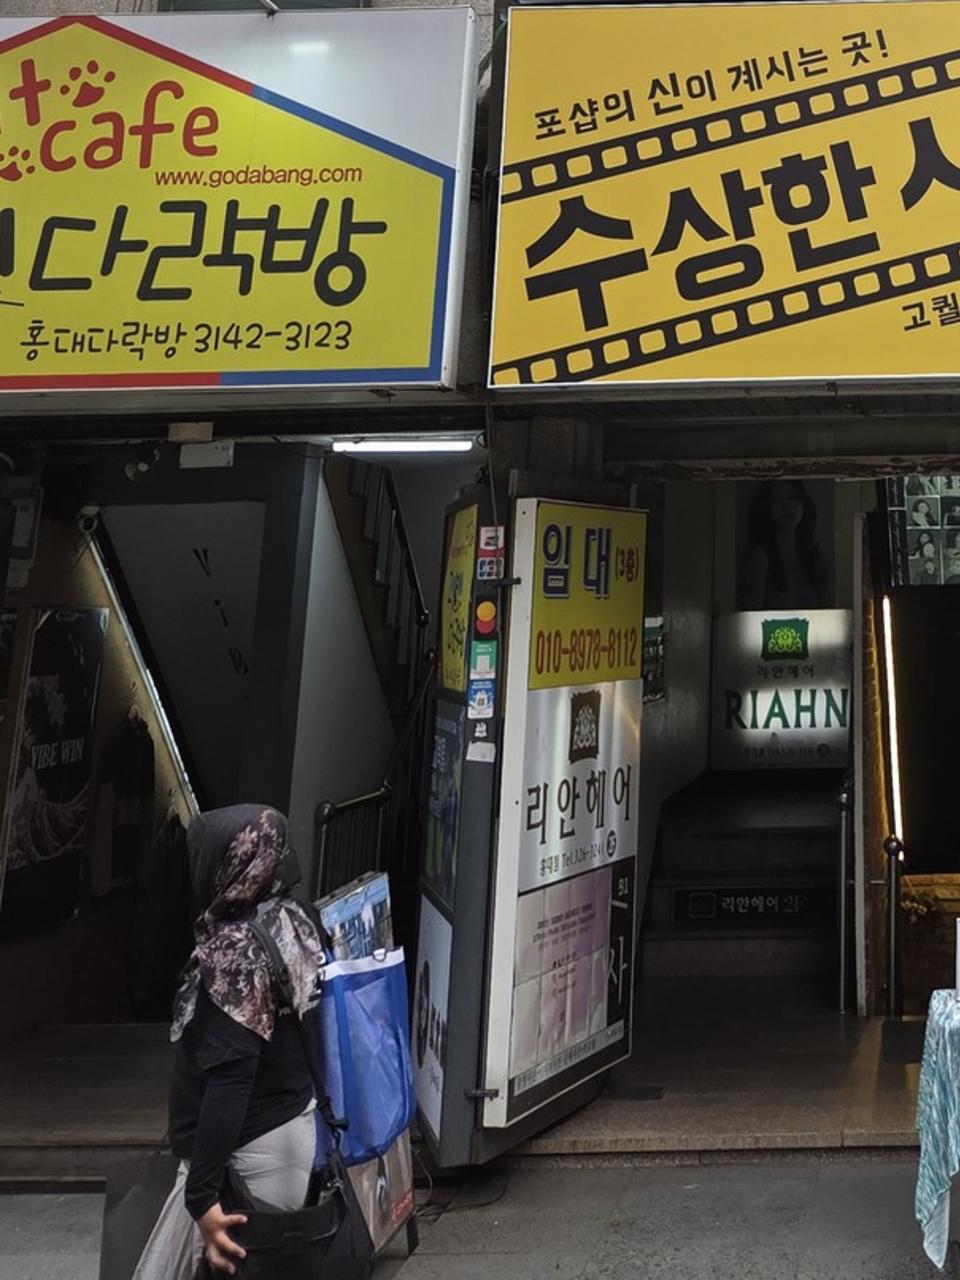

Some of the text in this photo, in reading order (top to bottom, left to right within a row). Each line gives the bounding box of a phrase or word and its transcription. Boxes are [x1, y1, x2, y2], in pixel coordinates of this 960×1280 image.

[534, 28, 890, 141] 포샵의 신이 계시는 곳!
[40, 80, 219, 173] cafe
[155, 165, 363, 188] www.godabang.com
[524, 140, 882, 333] 수상한
[20, 320, 353, 361] 홍대다락방 3142-3123
[542, 523, 612, 599] 임대
[536, 626, 638, 675] 010-8978-8112
[725, 688, 849, 730] RIAHN
[526, 763, 632, 845] 리안헤어
